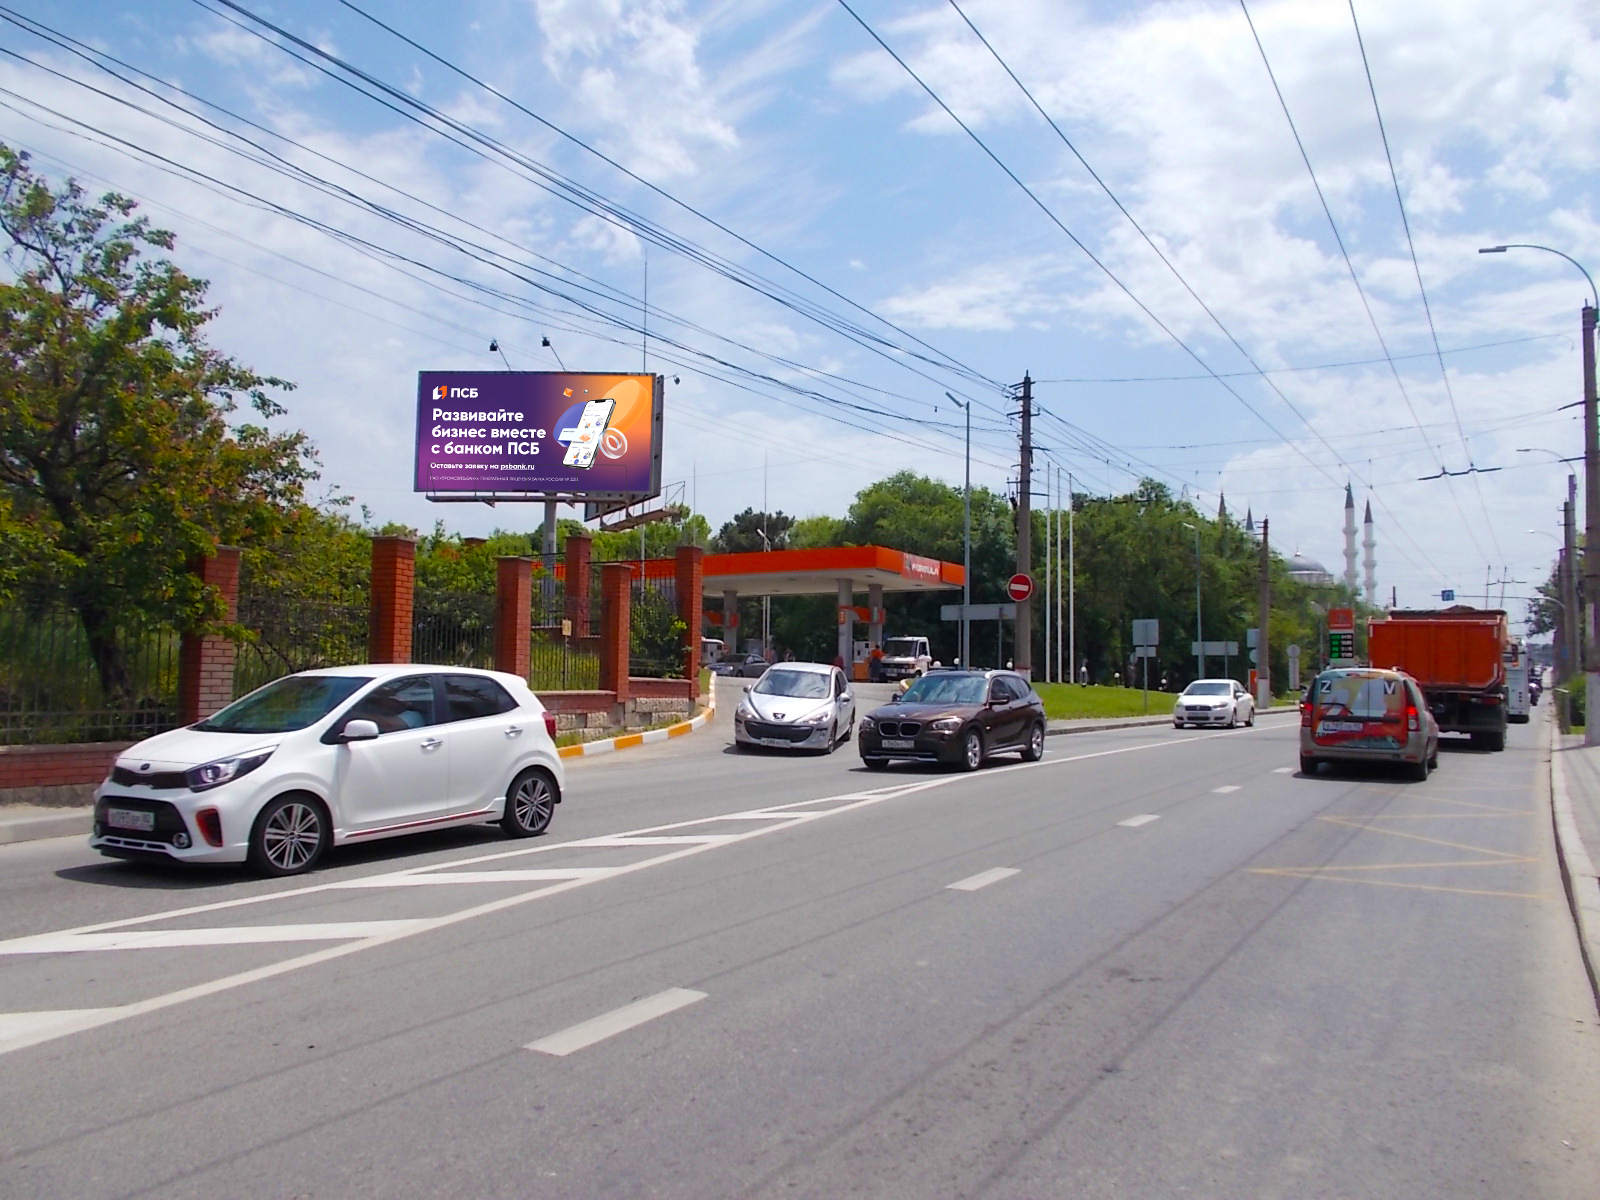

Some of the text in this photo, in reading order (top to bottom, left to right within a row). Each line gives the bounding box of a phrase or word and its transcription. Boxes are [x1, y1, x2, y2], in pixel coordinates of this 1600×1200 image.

[450, 387, 479, 399] ПСБ
[432, 407, 524, 422] Развивайте
[431, 424, 547, 439] бизнес вместе
[431, 440, 540, 455] с банком ПСБ
[430, 462, 464, 470] Оставьте
[465, 463, 489, 472] заявку
[500, 462, 535, 472] psbank.ru
[1320, 681, 1331, 693] Z
[1384, 682, 1396, 694] V
